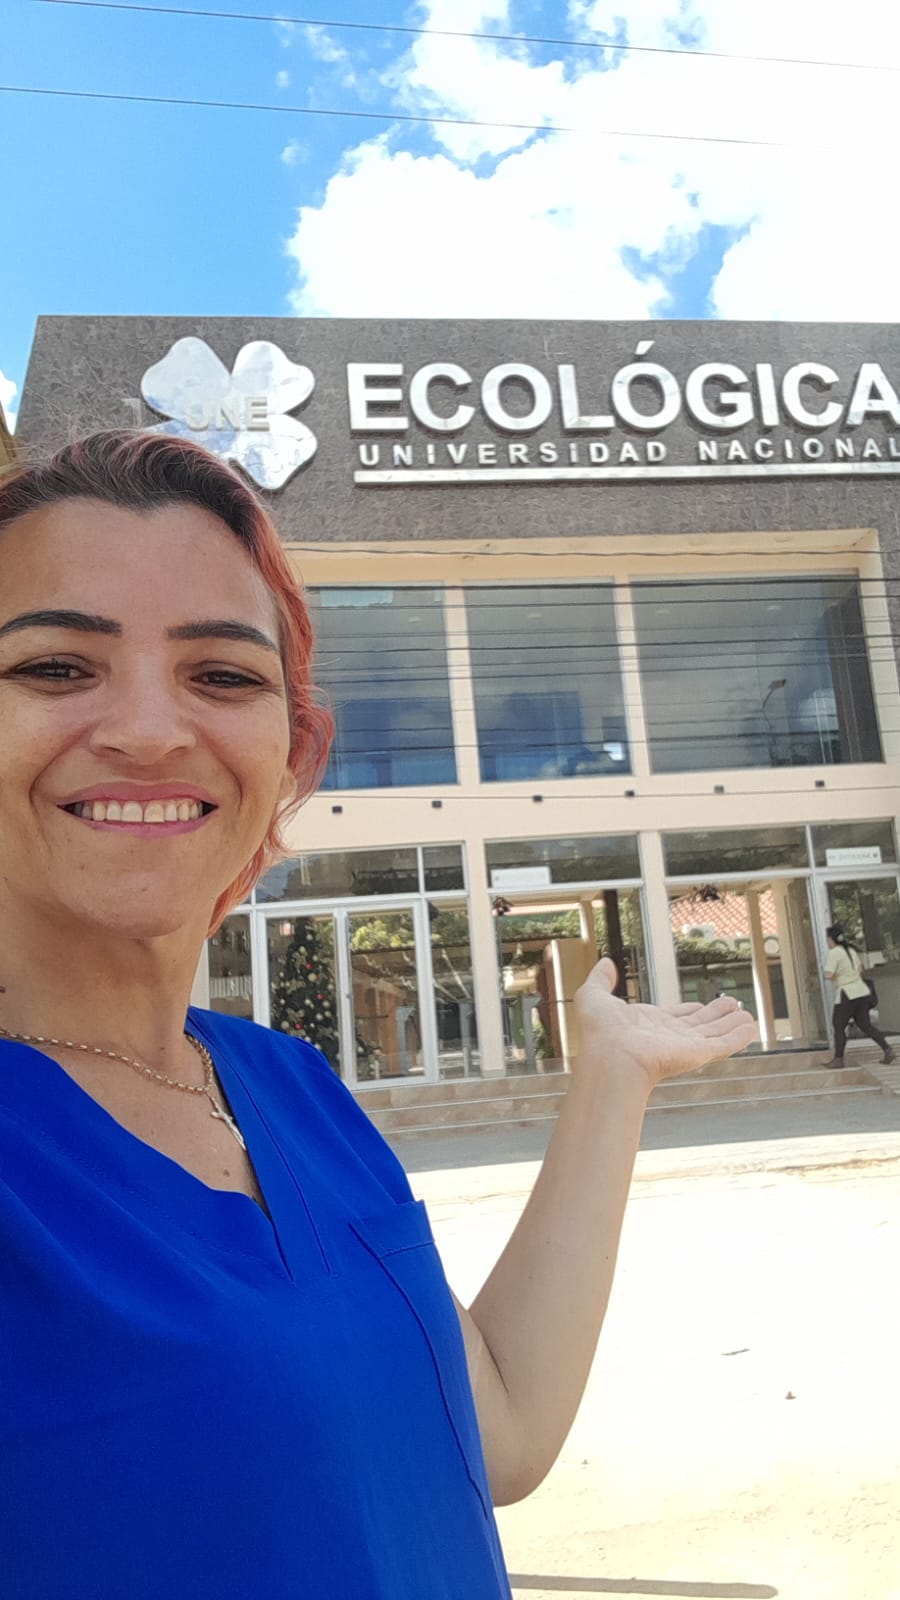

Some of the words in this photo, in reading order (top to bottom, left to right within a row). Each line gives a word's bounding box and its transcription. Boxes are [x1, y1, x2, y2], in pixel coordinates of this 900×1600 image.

[347, 340, 900, 431] ECOLÓGICA
[184, 396, 270, 432] UNE
[358, 441, 667, 466] UNIVERSIDAD
[697, 437, 900, 461] NACIONAL
